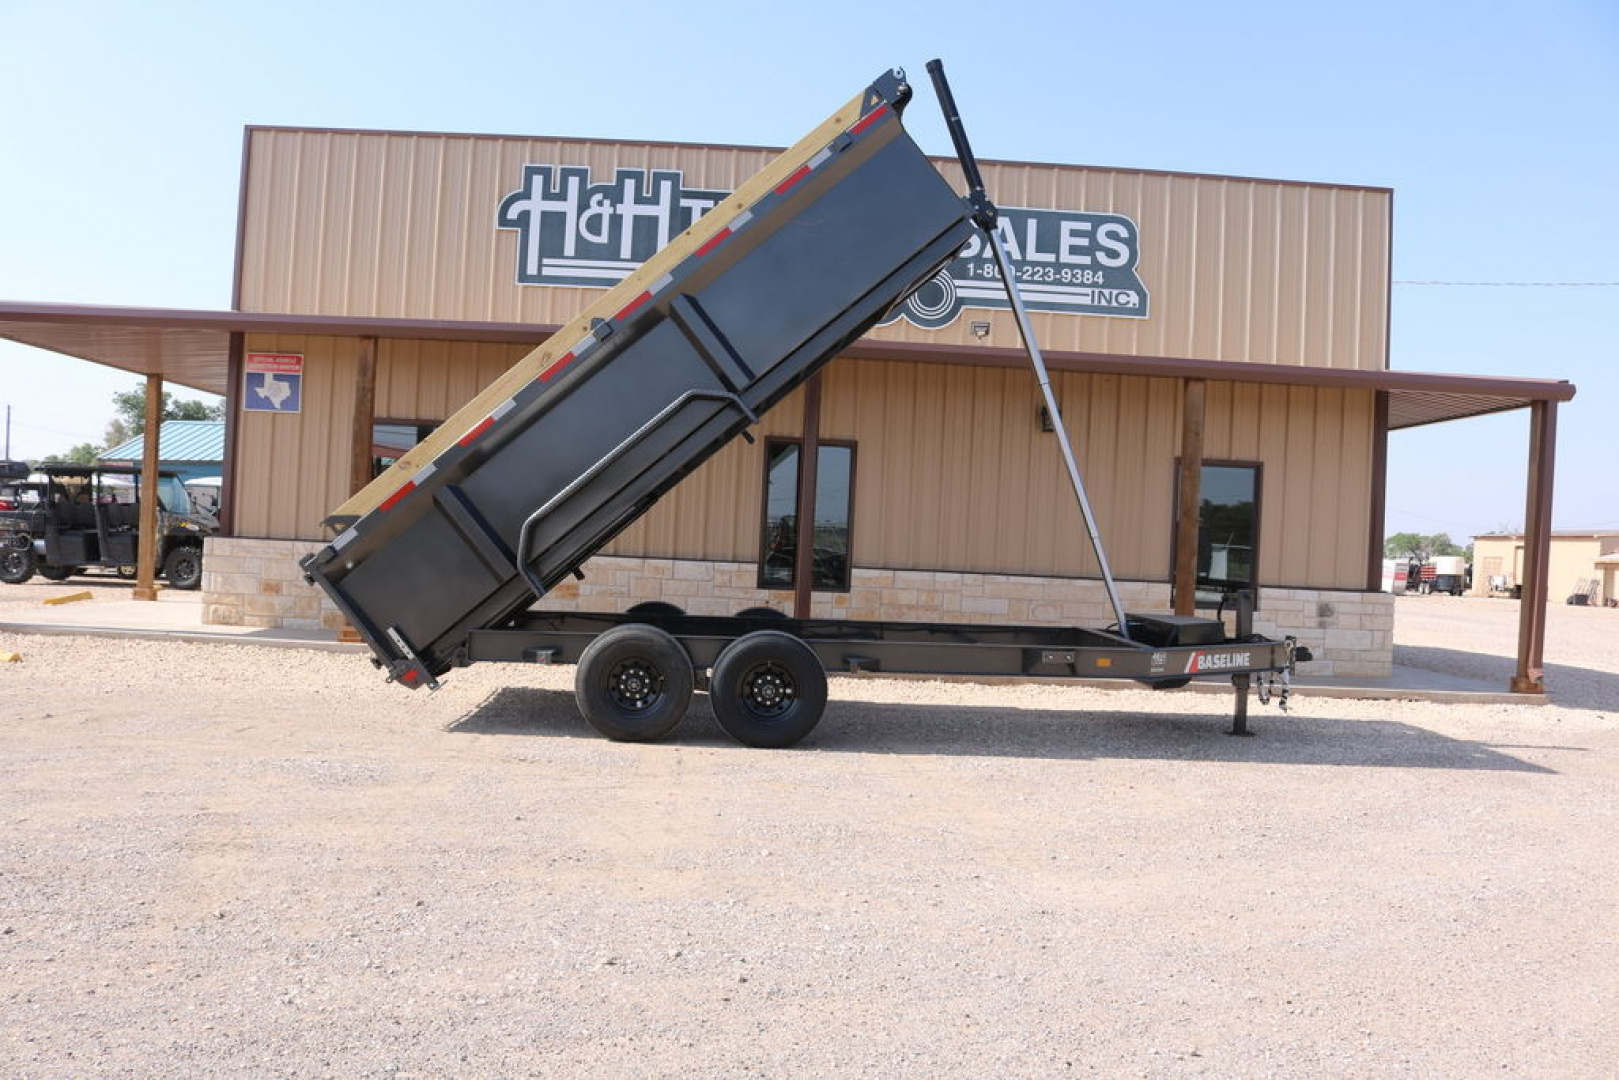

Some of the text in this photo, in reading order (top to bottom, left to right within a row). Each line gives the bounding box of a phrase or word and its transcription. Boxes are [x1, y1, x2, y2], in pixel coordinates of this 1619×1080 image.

[506, 174, 672, 276] H&H
[1090, 289, 1138, 308] INC.
[1197, 652, 1251, 670] BASELINE
